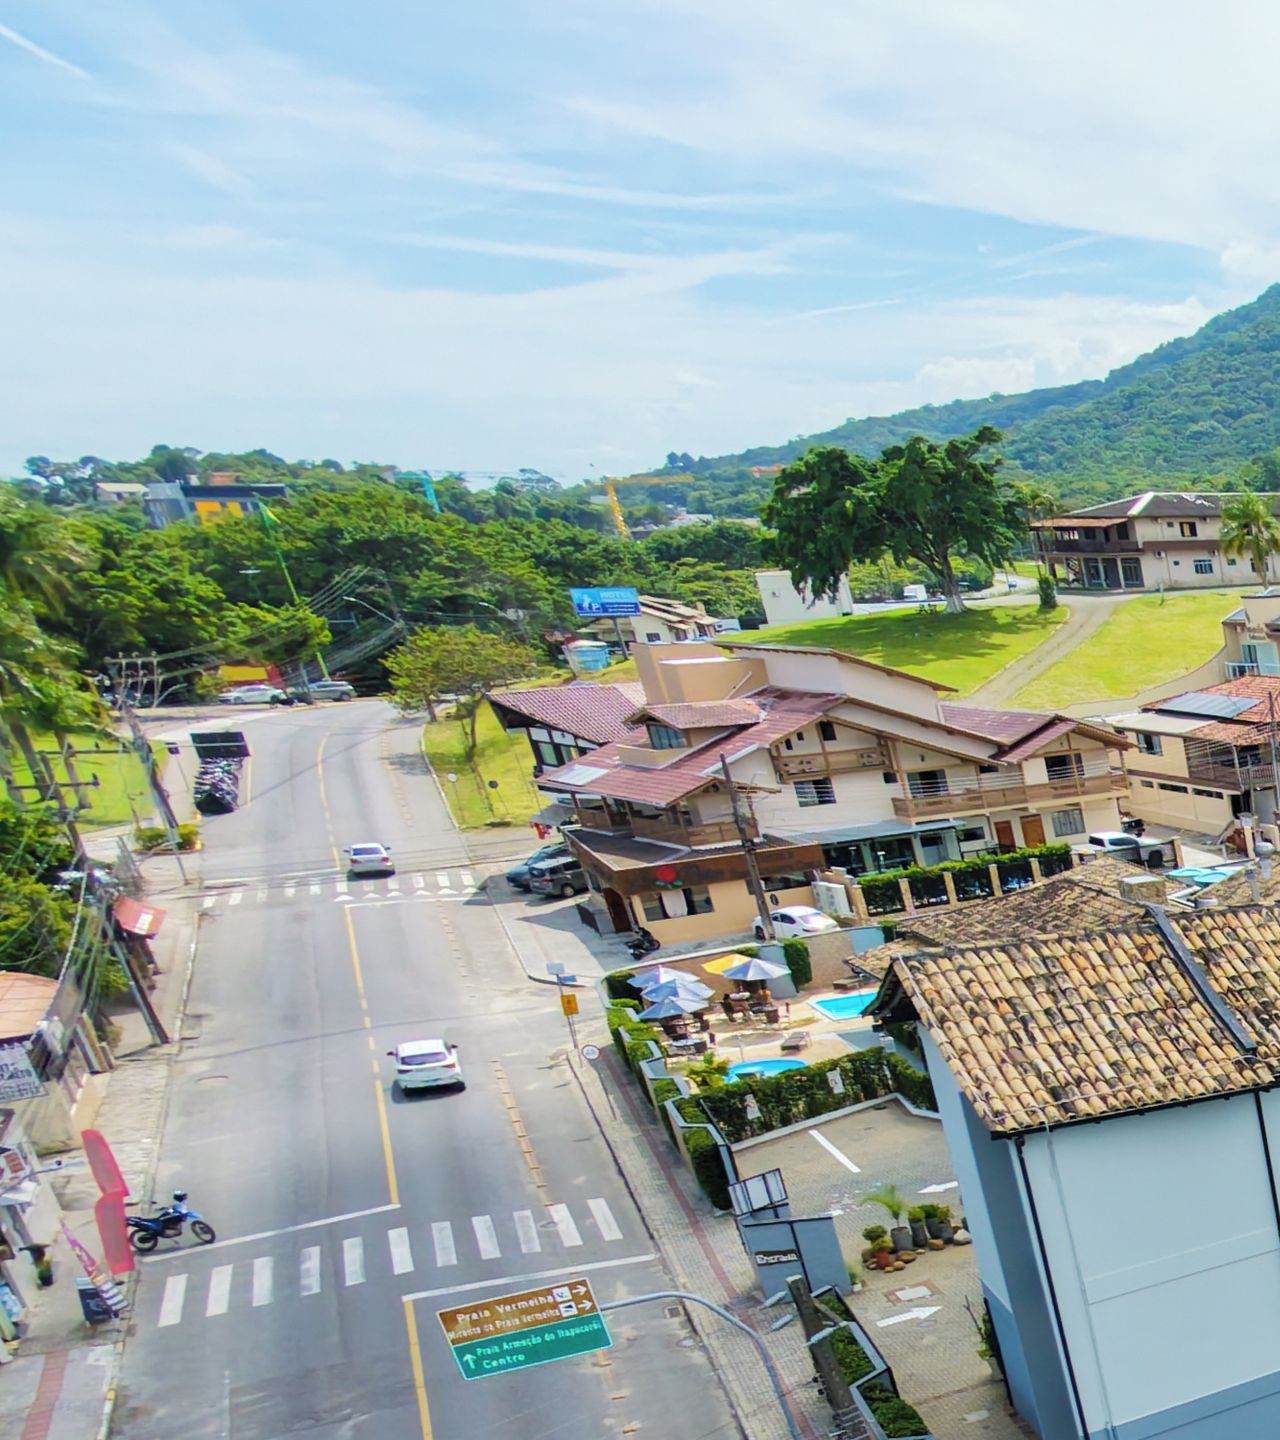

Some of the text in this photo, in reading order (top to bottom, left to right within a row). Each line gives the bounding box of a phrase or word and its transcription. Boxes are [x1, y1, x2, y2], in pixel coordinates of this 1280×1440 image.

[456, 1295, 555, 1324] Praia Vermelha
[495, 1317, 520, 1329] Praia
[476, 1345, 500, 1357] Praia
[483, 1353, 526, 1369] Centro
